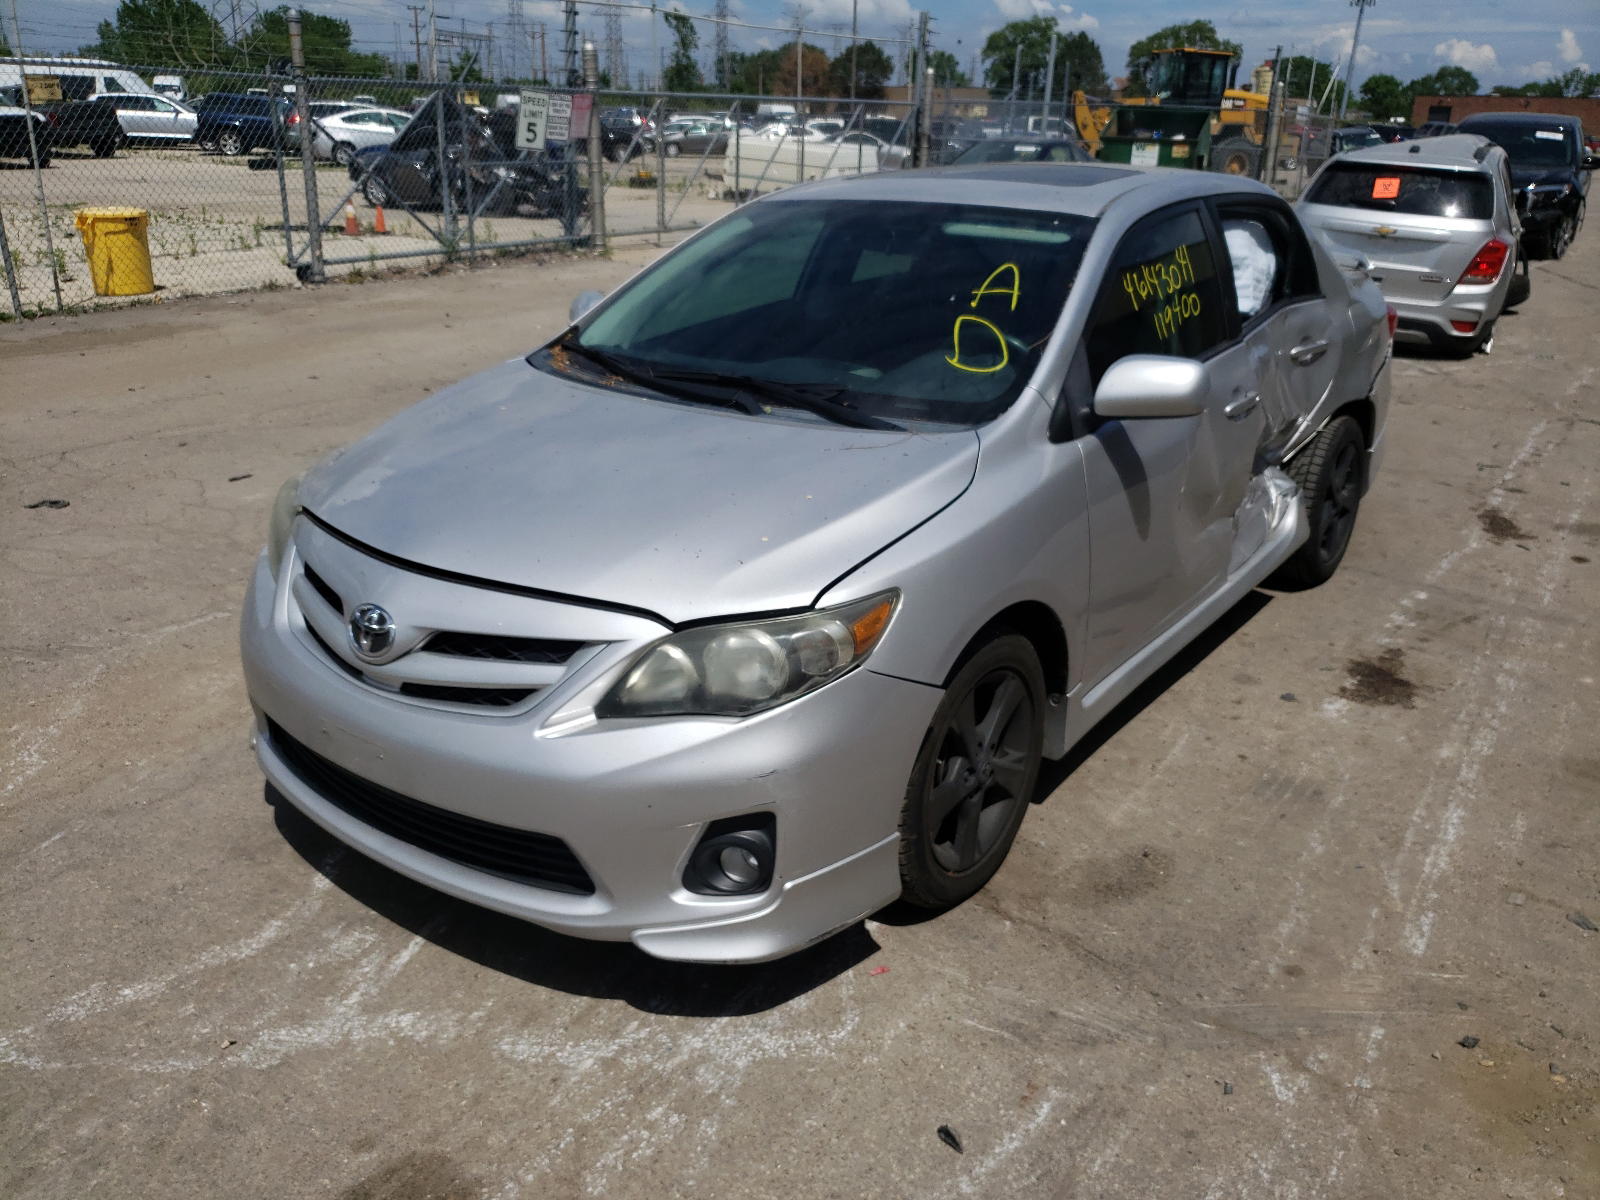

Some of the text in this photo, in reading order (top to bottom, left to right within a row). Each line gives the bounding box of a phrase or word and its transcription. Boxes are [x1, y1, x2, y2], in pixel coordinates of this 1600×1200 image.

[521, 95, 547, 107] SPEED
[524, 108, 543, 119] LIMIT
[525, 122, 538, 143] 5
[970, 262, 1021, 312] A
[944, 313, 1010, 373] D
